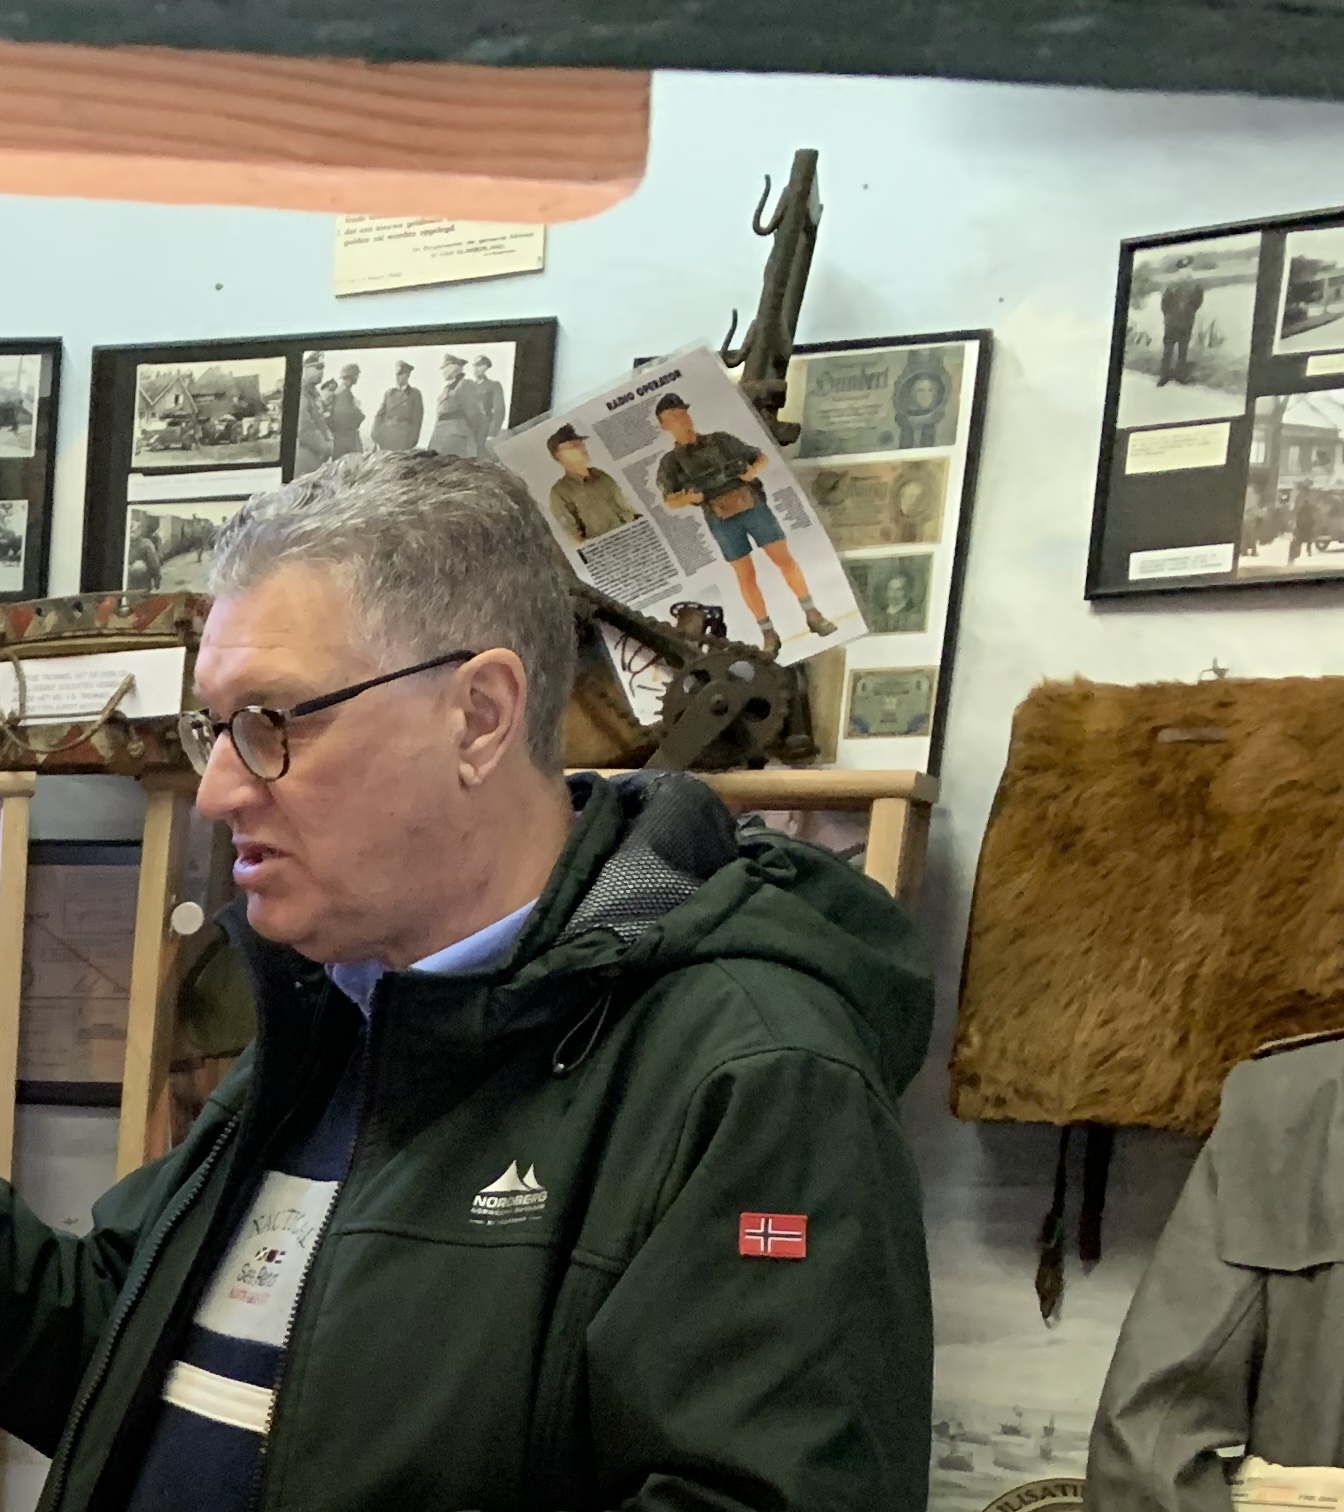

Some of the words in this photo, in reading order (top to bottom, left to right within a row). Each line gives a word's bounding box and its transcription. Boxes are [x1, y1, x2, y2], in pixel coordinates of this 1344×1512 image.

[606, 389, 635, 411] RADIO
[636, 369, 682, 396] OPERATOR
[472, 1191, 548, 1208] NORDBERG
